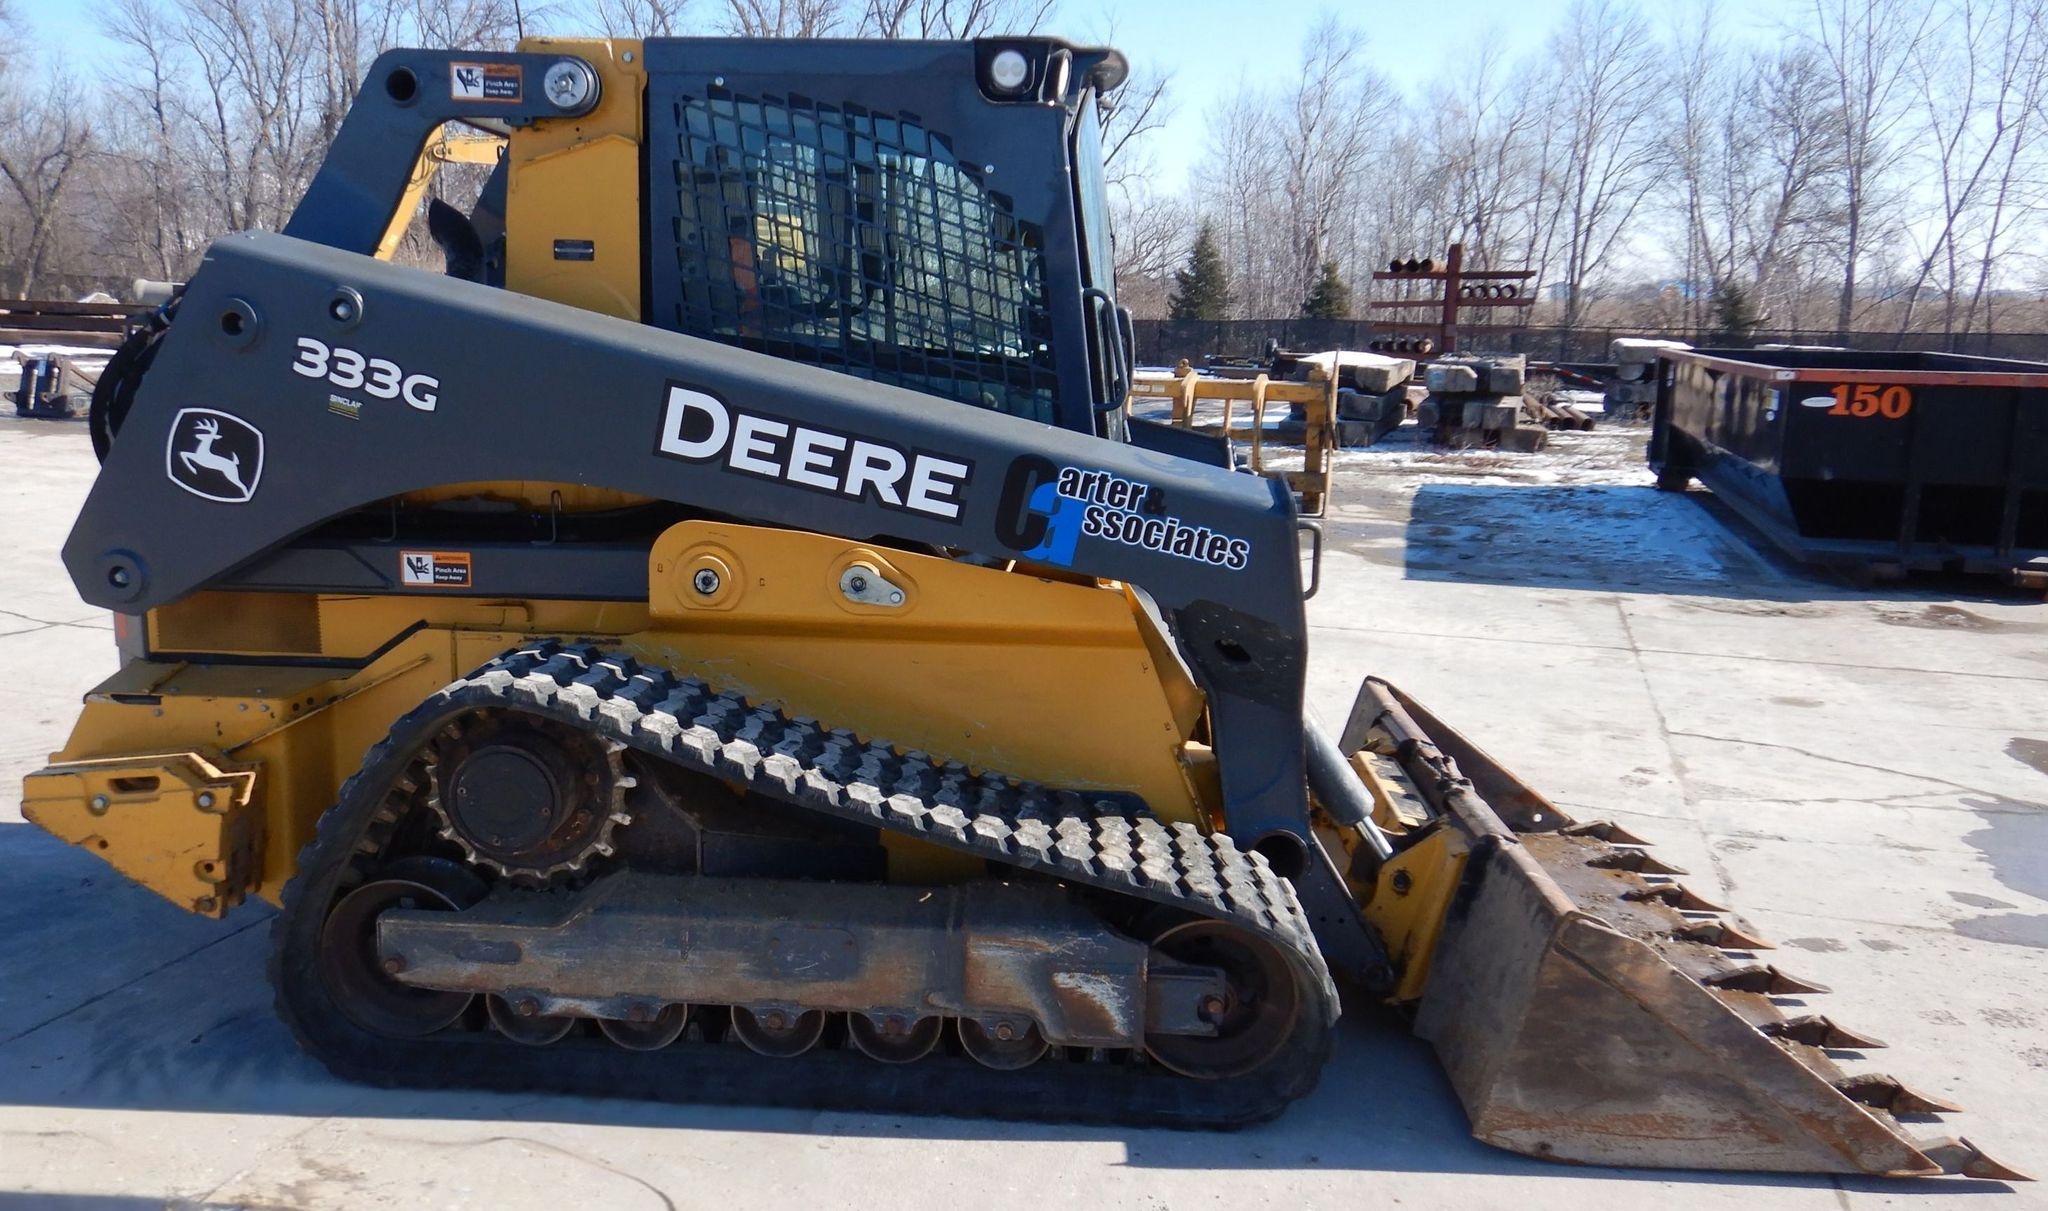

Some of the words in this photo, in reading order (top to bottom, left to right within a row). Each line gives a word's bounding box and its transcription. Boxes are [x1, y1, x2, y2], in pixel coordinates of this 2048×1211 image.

[292, 337, 439, 412] 333G
[1827, 383, 1912, 419] 150
[660, 386, 968, 518] DEERE
